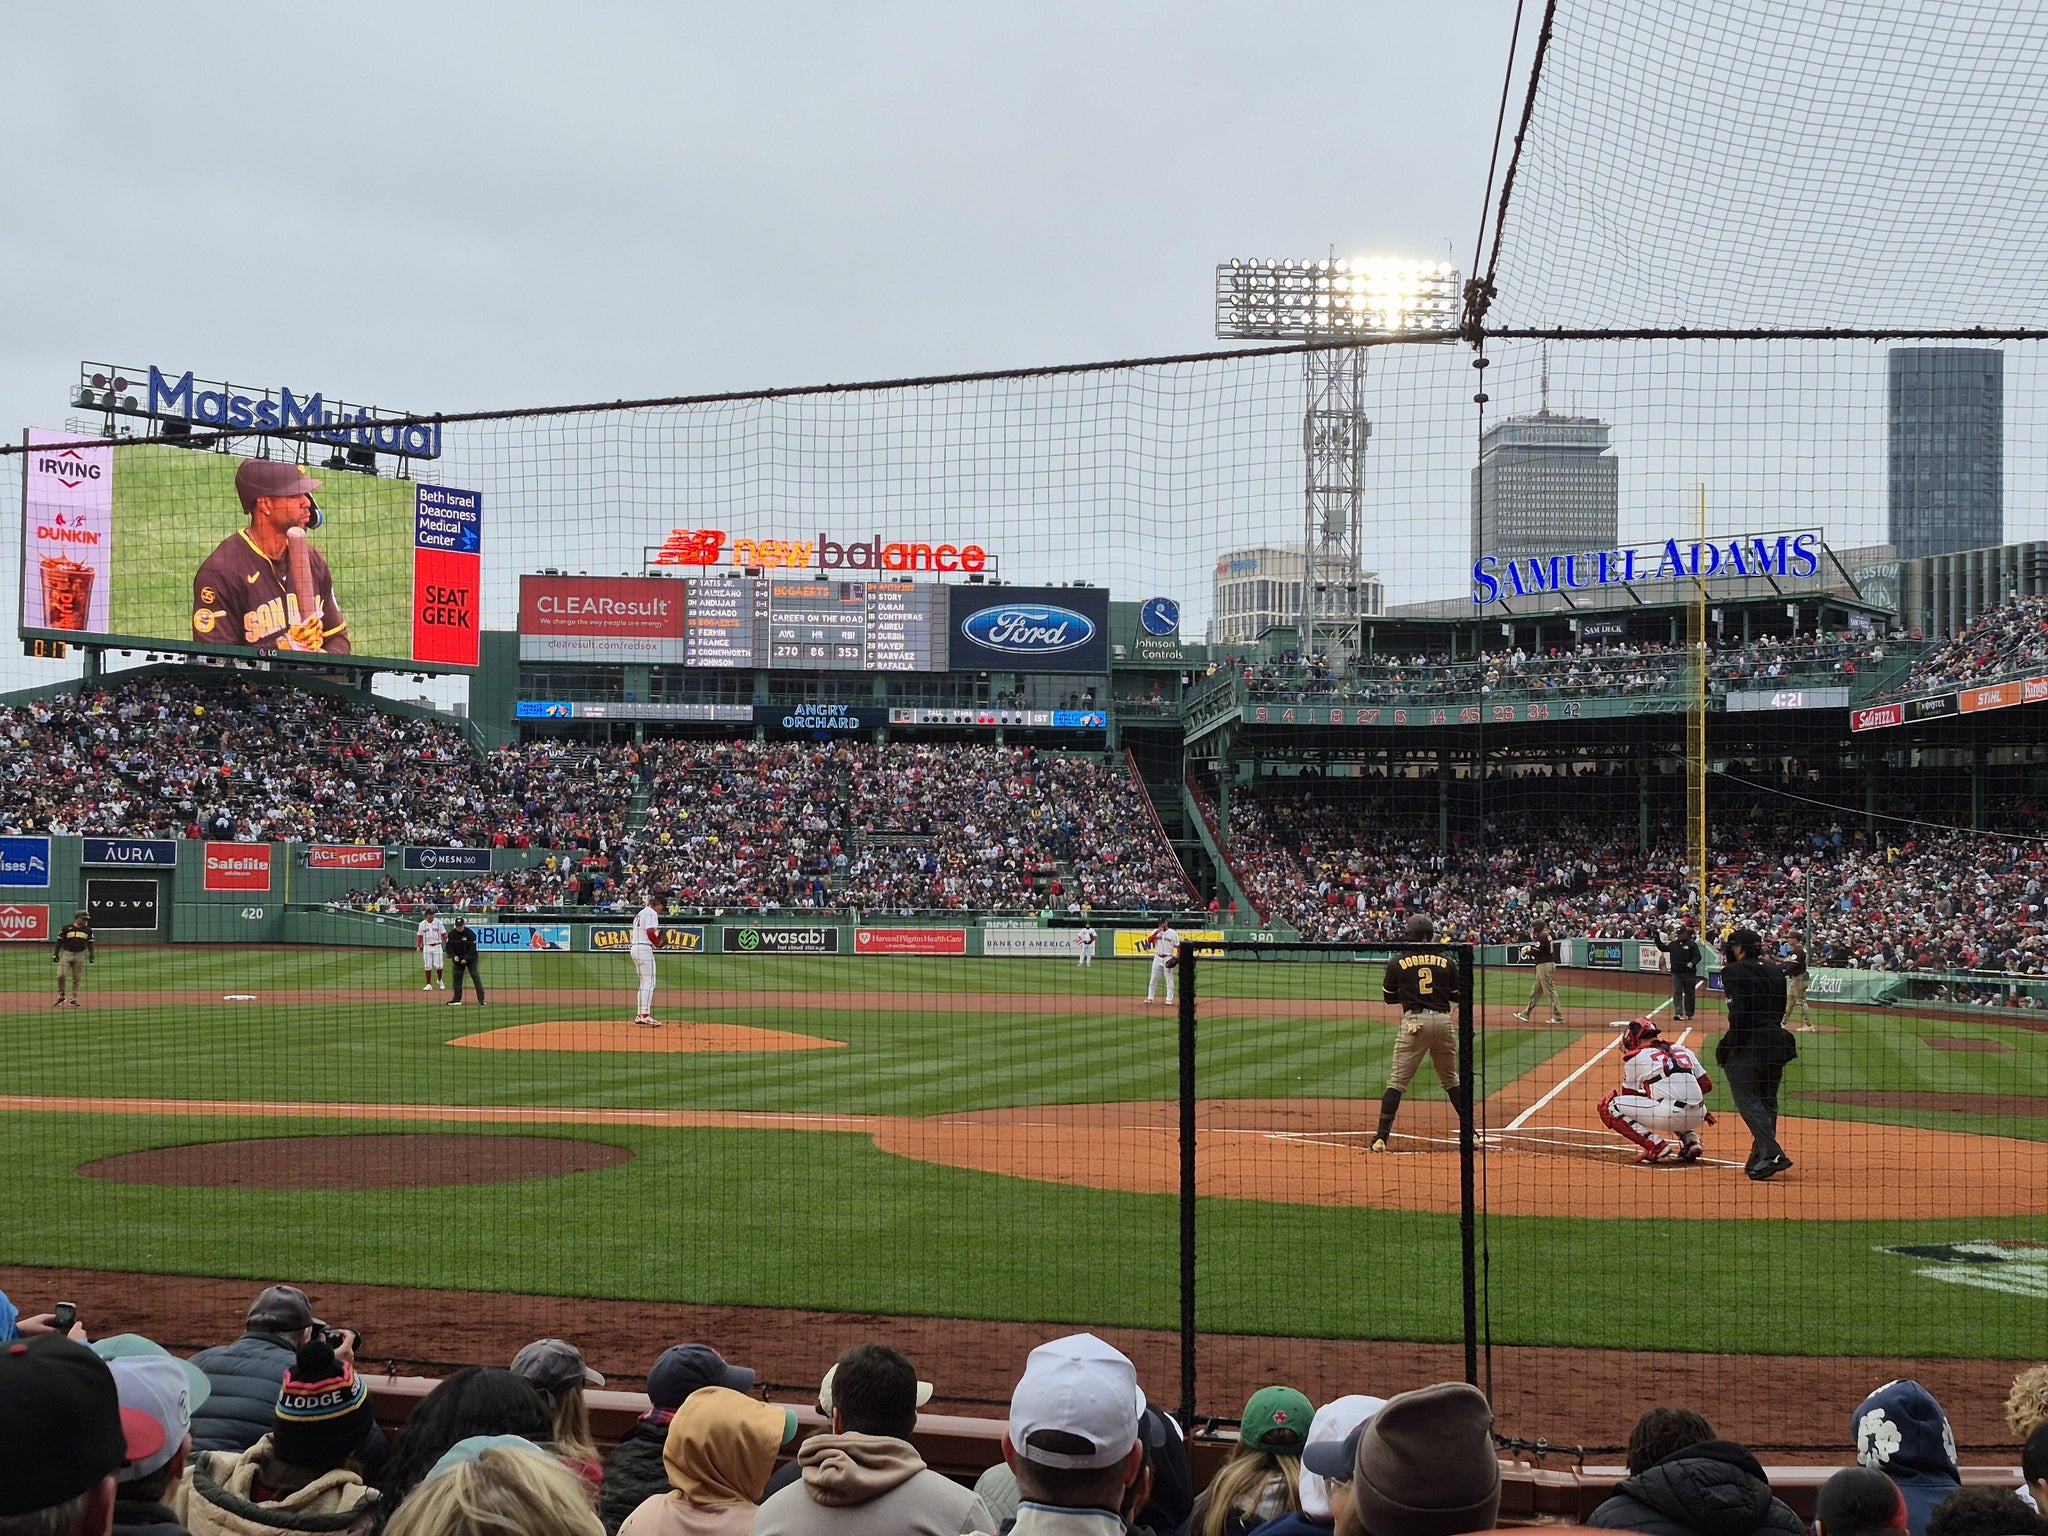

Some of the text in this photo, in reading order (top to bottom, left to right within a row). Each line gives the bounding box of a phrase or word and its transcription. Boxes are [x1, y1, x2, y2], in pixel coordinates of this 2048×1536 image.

[149, 365, 441, 459] MassMutual
[1520, 428, 1592, 436] PRUDENTIAL
[39, 458, 101, 480] IRVING
[420, 489, 474, 508] Beth Israel
[420, 504, 476, 522] Deaconess
[420, 518, 460, 534] Medical
[38, 526, 102, 545] DUNKIN'
[419, 531, 456, 546] Center
[733, 538, 813, 568] new
[819, 533, 986, 572] balance
[1472, 533, 1818, 606] SAMUEL ADAMS
[1854, 563, 1898, 584] BOSTON
[425, 586, 469, 606] SEAT
[774, 586, 830, 596] BOGAERTS
[536, 596, 669, 616] CLEAResult
[244, 596, 286, 642] SAN
[422, 606, 470, 628] GEEK
[552, 618, 576, 626] change
[772, 614, 804, 622] CAREER
[808, 614, 819, 622] ON
[778, 630, 856, 640] AVG HR RBI
[988, 611, 1068, 645] Ford
[548, 639, 658, 650] clearesult.com/redsox
[774, 646, 859, 657] .270 86 353
[1135, 638, 1176, 650] Johnson
[698, 649, 751, 657] CRONENWORTH
[1142, 650, 1183, 660] Controls
[878, 662, 914, 670] RAFAELA
[1771, 692, 1802, 707] 4:21
[1978, 690, 2002, 706] STIHL
[794, 704, 848, 716] ANGRY
[1256, 707, 1268, 723] 9
[1282, 708, 1294, 723] 4
[1308, 708, 1316, 724] 1
[1330, 709, 1342, 724] 8
[1357, 709, 1380, 724] 27
[1430, 710, 1446, 724] 14
[1460, 708, 1480, 723] 45
[1492, 706, 1515, 722] 26
[1528, 704, 1548, 720] 34
[1564, 702, 1581, 717] 42
[1875, 710, 1895, 725] PIZZA
[782, 716, 860, 728] ORCHARD
[207, 857, 268, 870] Safelite
[314, 851, 382, 864] ACE TICKET
[438, 856, 476, 864] NESN 360
[1, 860, 26, 872] ises
[92, 900, 154, 908] VOLVO
[241, 908, 263, 919] 420
[0, 916, 37, 928] VING
[478, 928, 520, 944] tBlue
[666, 929, 700, 948] CITY
[762, 929, 825, 944] wasabi
[872, 935, 898, 943] Harvard
[900, 935, 923, 944] Pilgrim
[924, 935, 946, 943] Health
[1418, 968, 1433, 994] 2
[284, 1390, 343, 1408] LODGE
